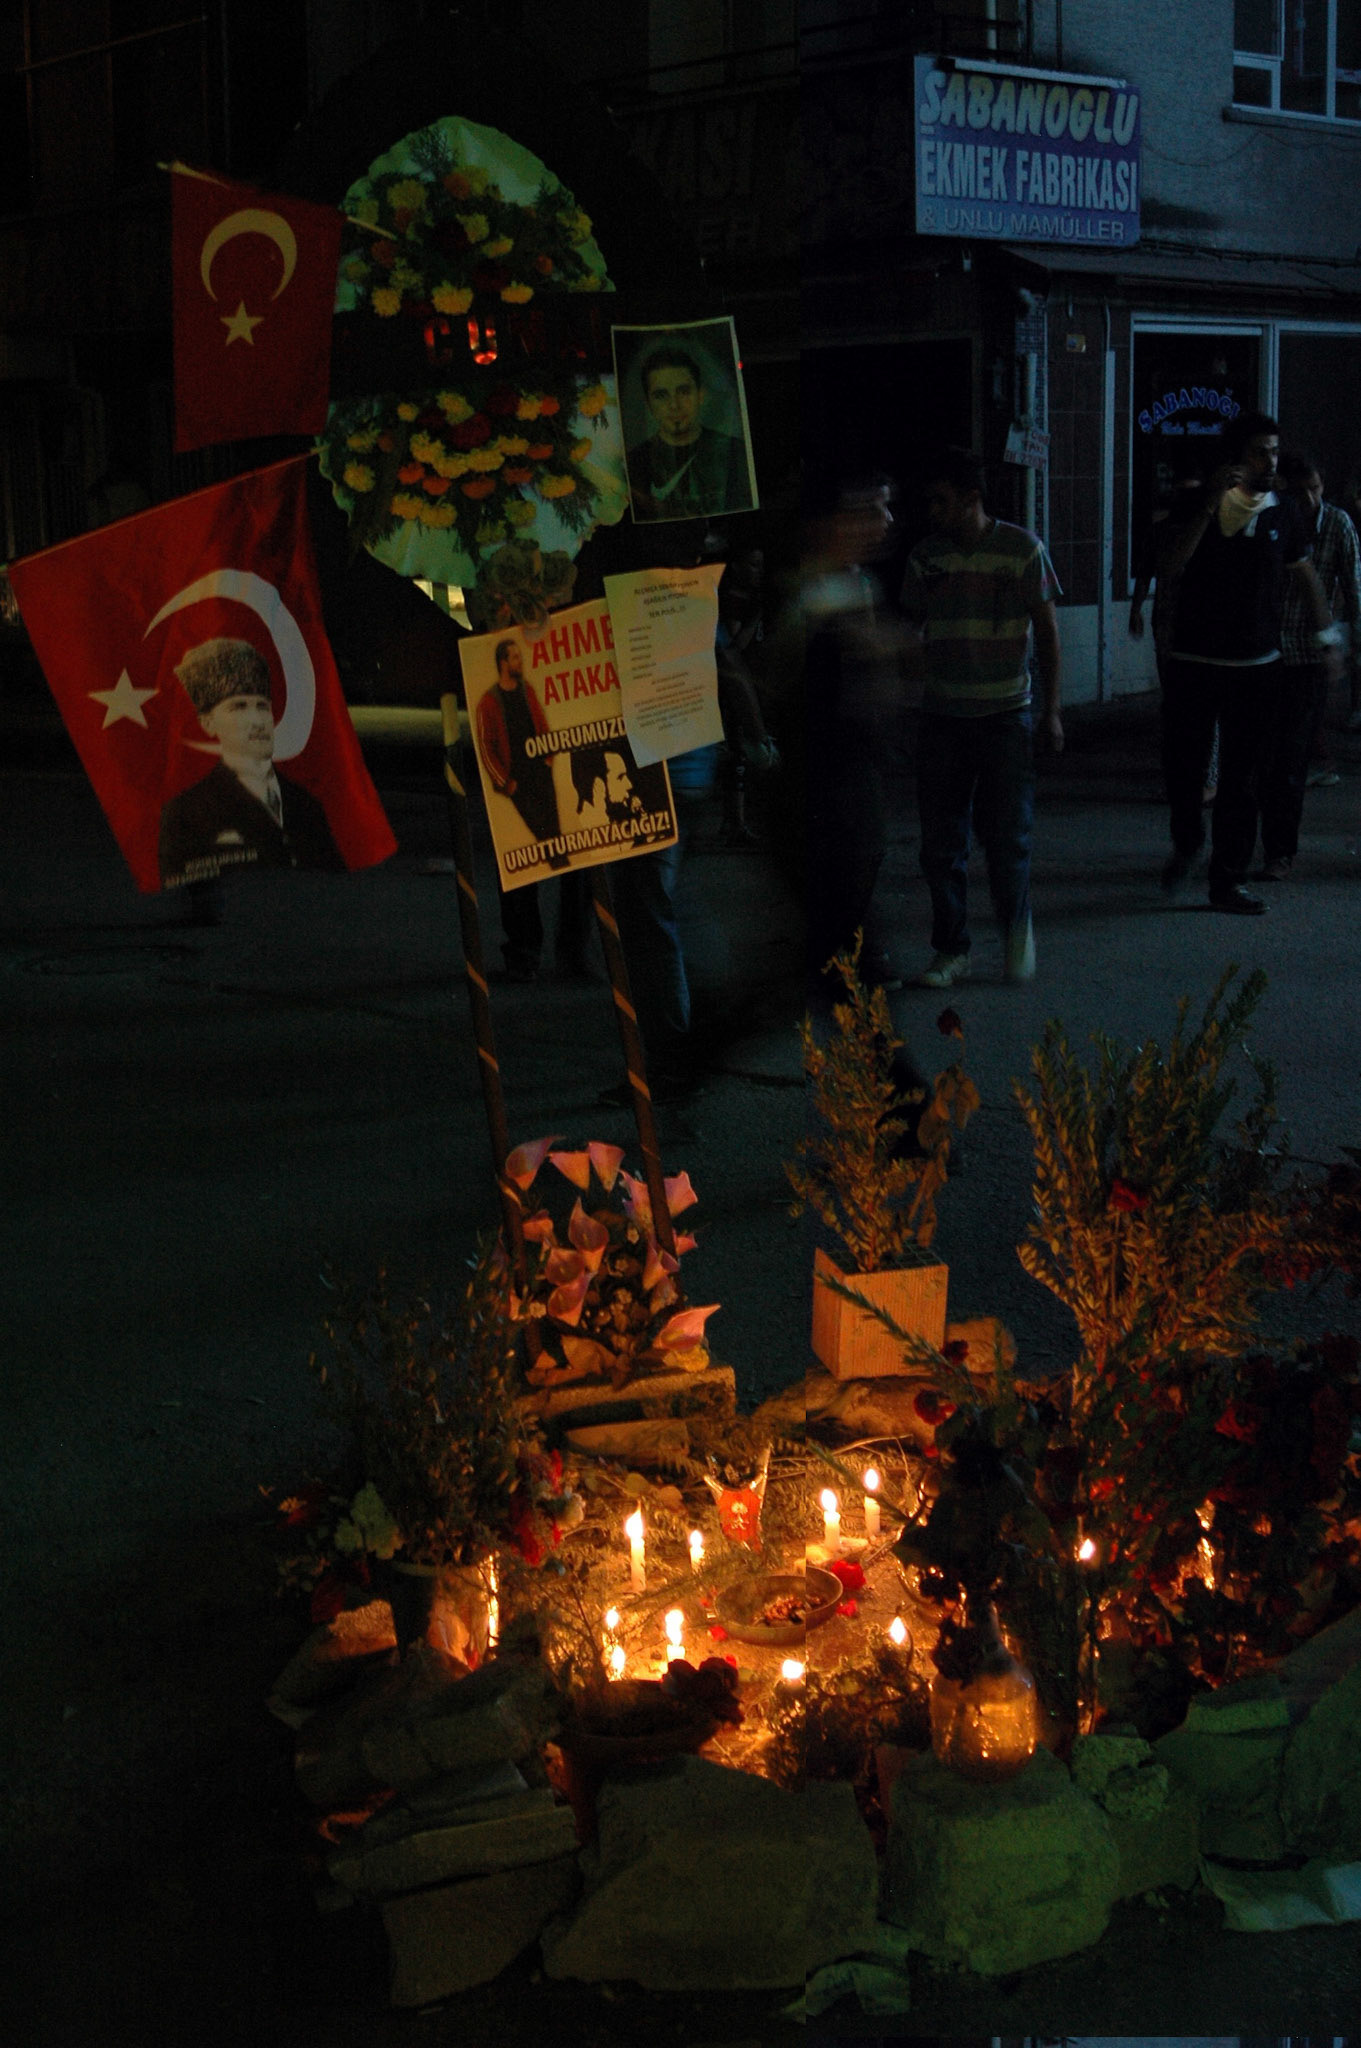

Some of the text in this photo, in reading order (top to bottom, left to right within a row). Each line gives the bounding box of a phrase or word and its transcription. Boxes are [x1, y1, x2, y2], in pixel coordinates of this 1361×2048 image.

[921, 140, 1008, 202] EKMEK
[920, 205, 936, 229] &
[944, 208, 1004, 233] UNLU
[532, 615, 615, 669] AHME
[544, 662, 621, 706] ATAKA
[525, 717, 627, 759] ONURUMUZD
[505, 811, 671, 871] UNUTTURMAYACAĞIZ!
